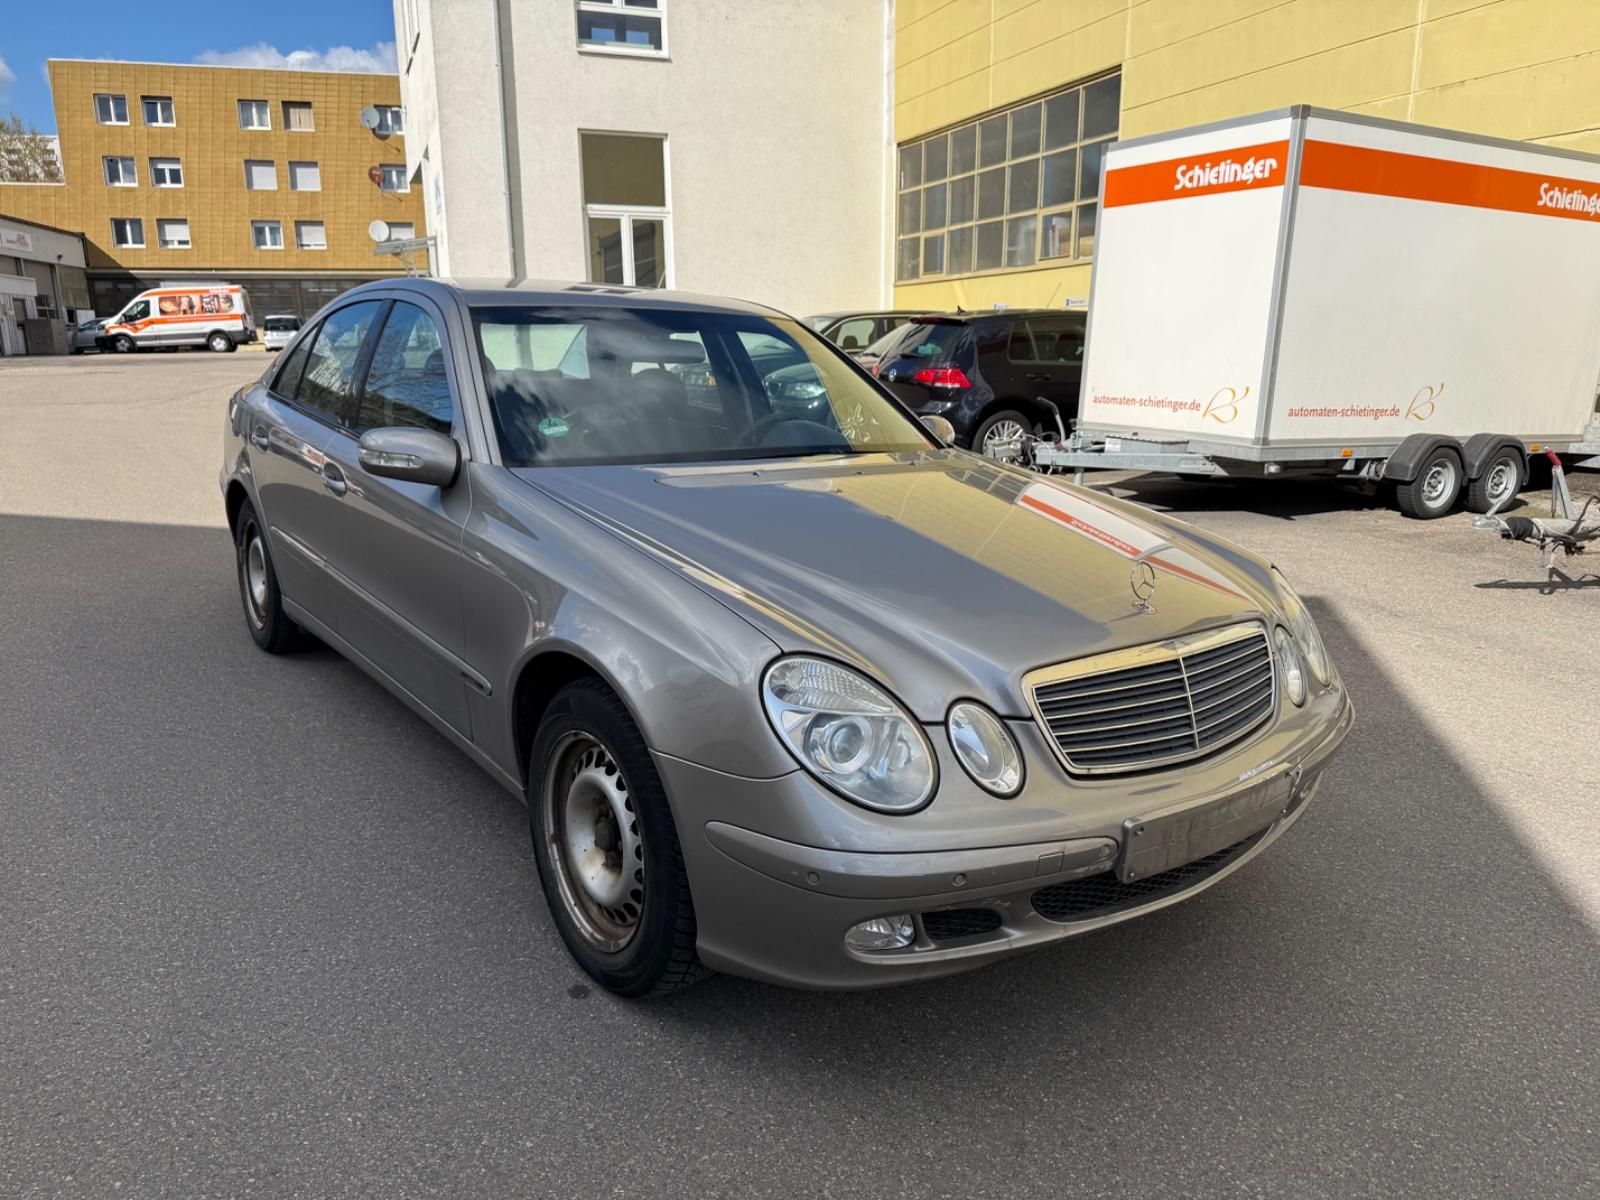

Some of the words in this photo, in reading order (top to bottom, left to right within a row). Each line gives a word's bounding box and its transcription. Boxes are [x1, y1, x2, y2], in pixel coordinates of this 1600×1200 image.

[1173, 156, 1278, 191] Schietinger
[1092, 393, 1201, 412] automaten-schietinger.de
[1287, 404, 1400, 420] automaten-schietinger.de
